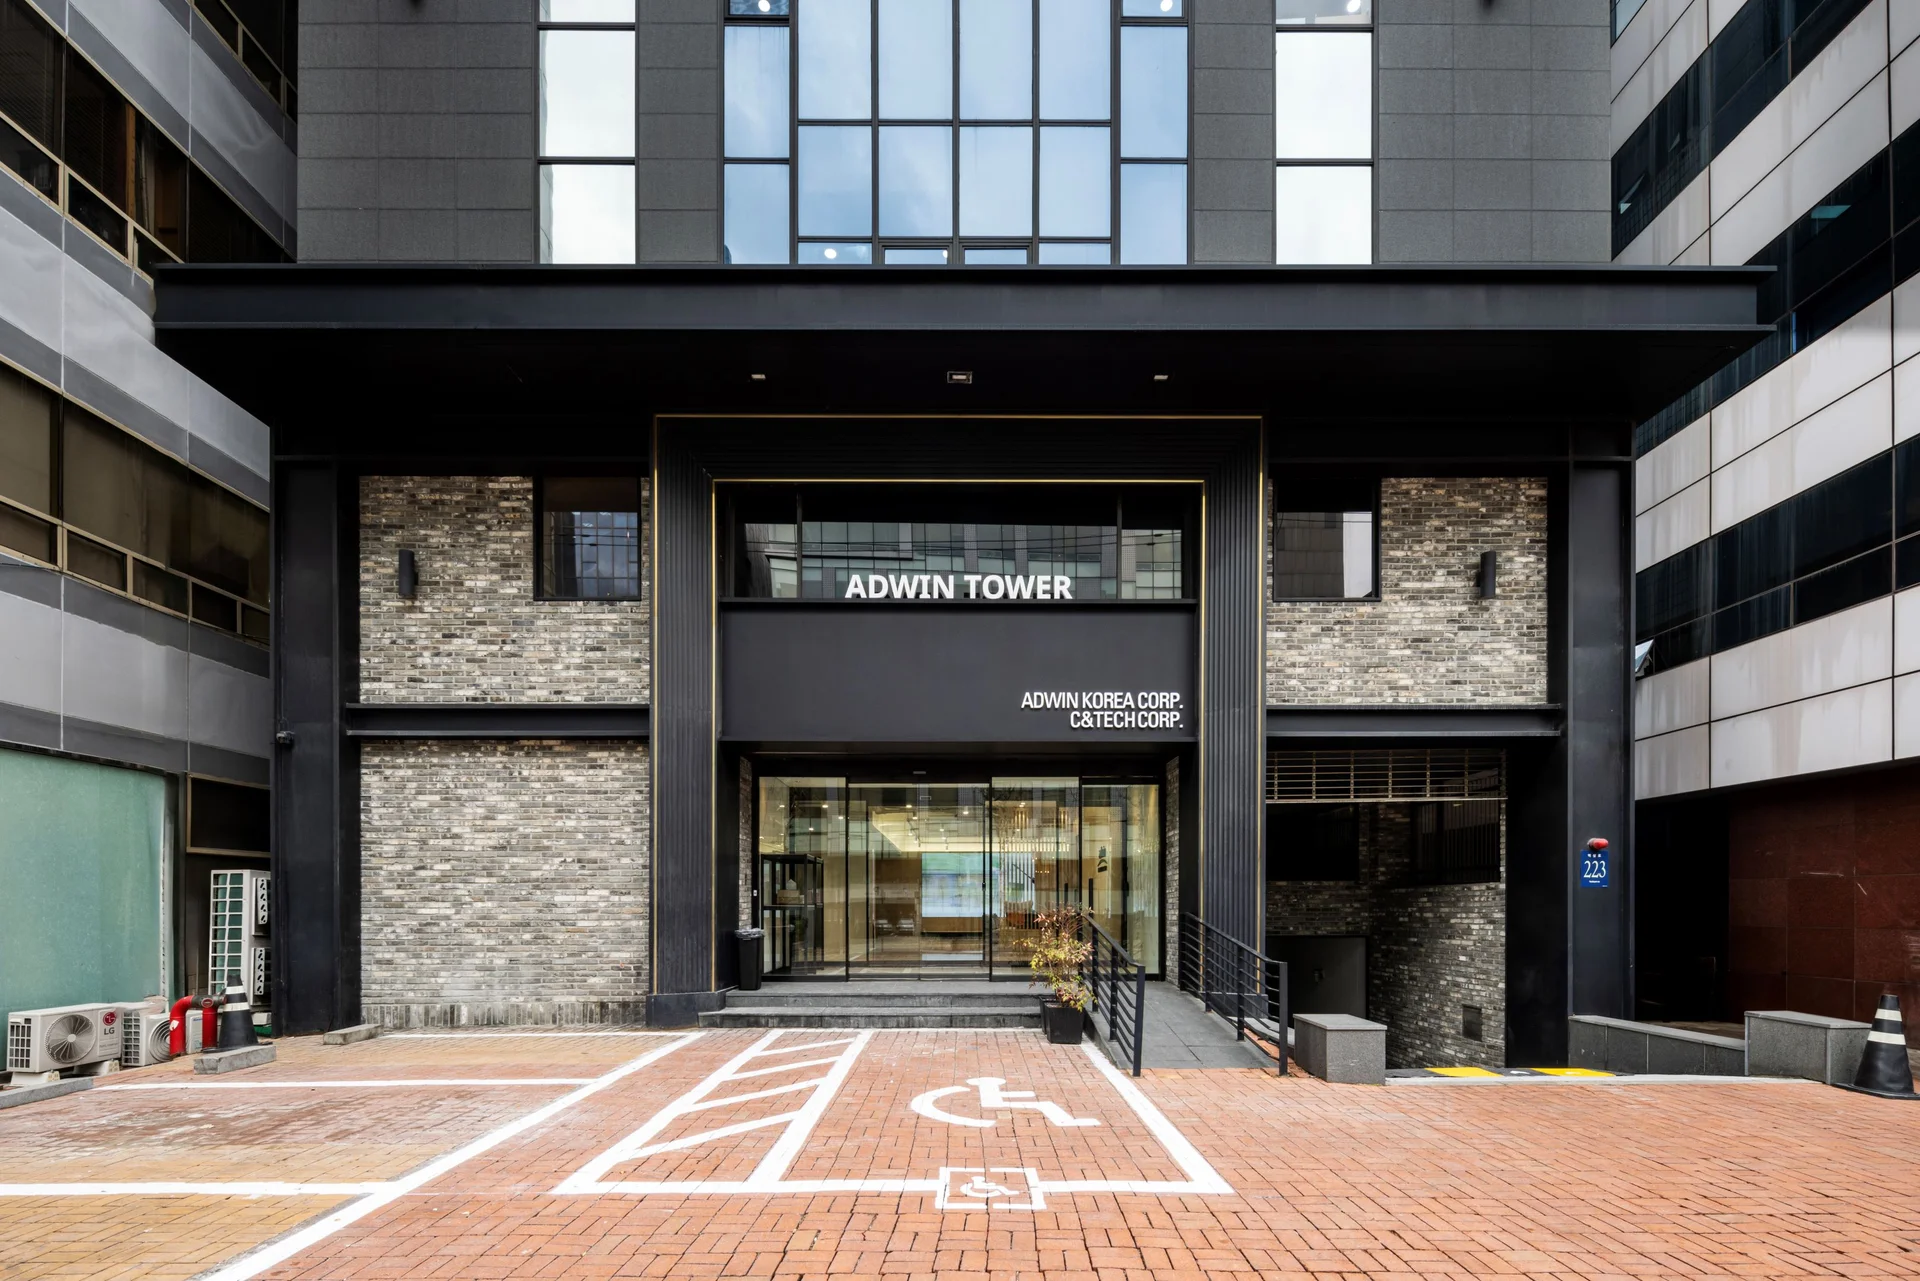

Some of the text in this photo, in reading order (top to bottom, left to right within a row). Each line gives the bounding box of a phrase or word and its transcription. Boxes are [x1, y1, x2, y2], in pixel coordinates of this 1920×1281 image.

[844, 574, 1073, 600] ADWIN TOWER
[1021, 691, 1184, 709] ADWIN KOREA CORP.
[1070, 711, 1184, 729] C&TECH CORP.
[1583, 860, 1606, 878] 223
[103, 1027, 115, 1035] LG
